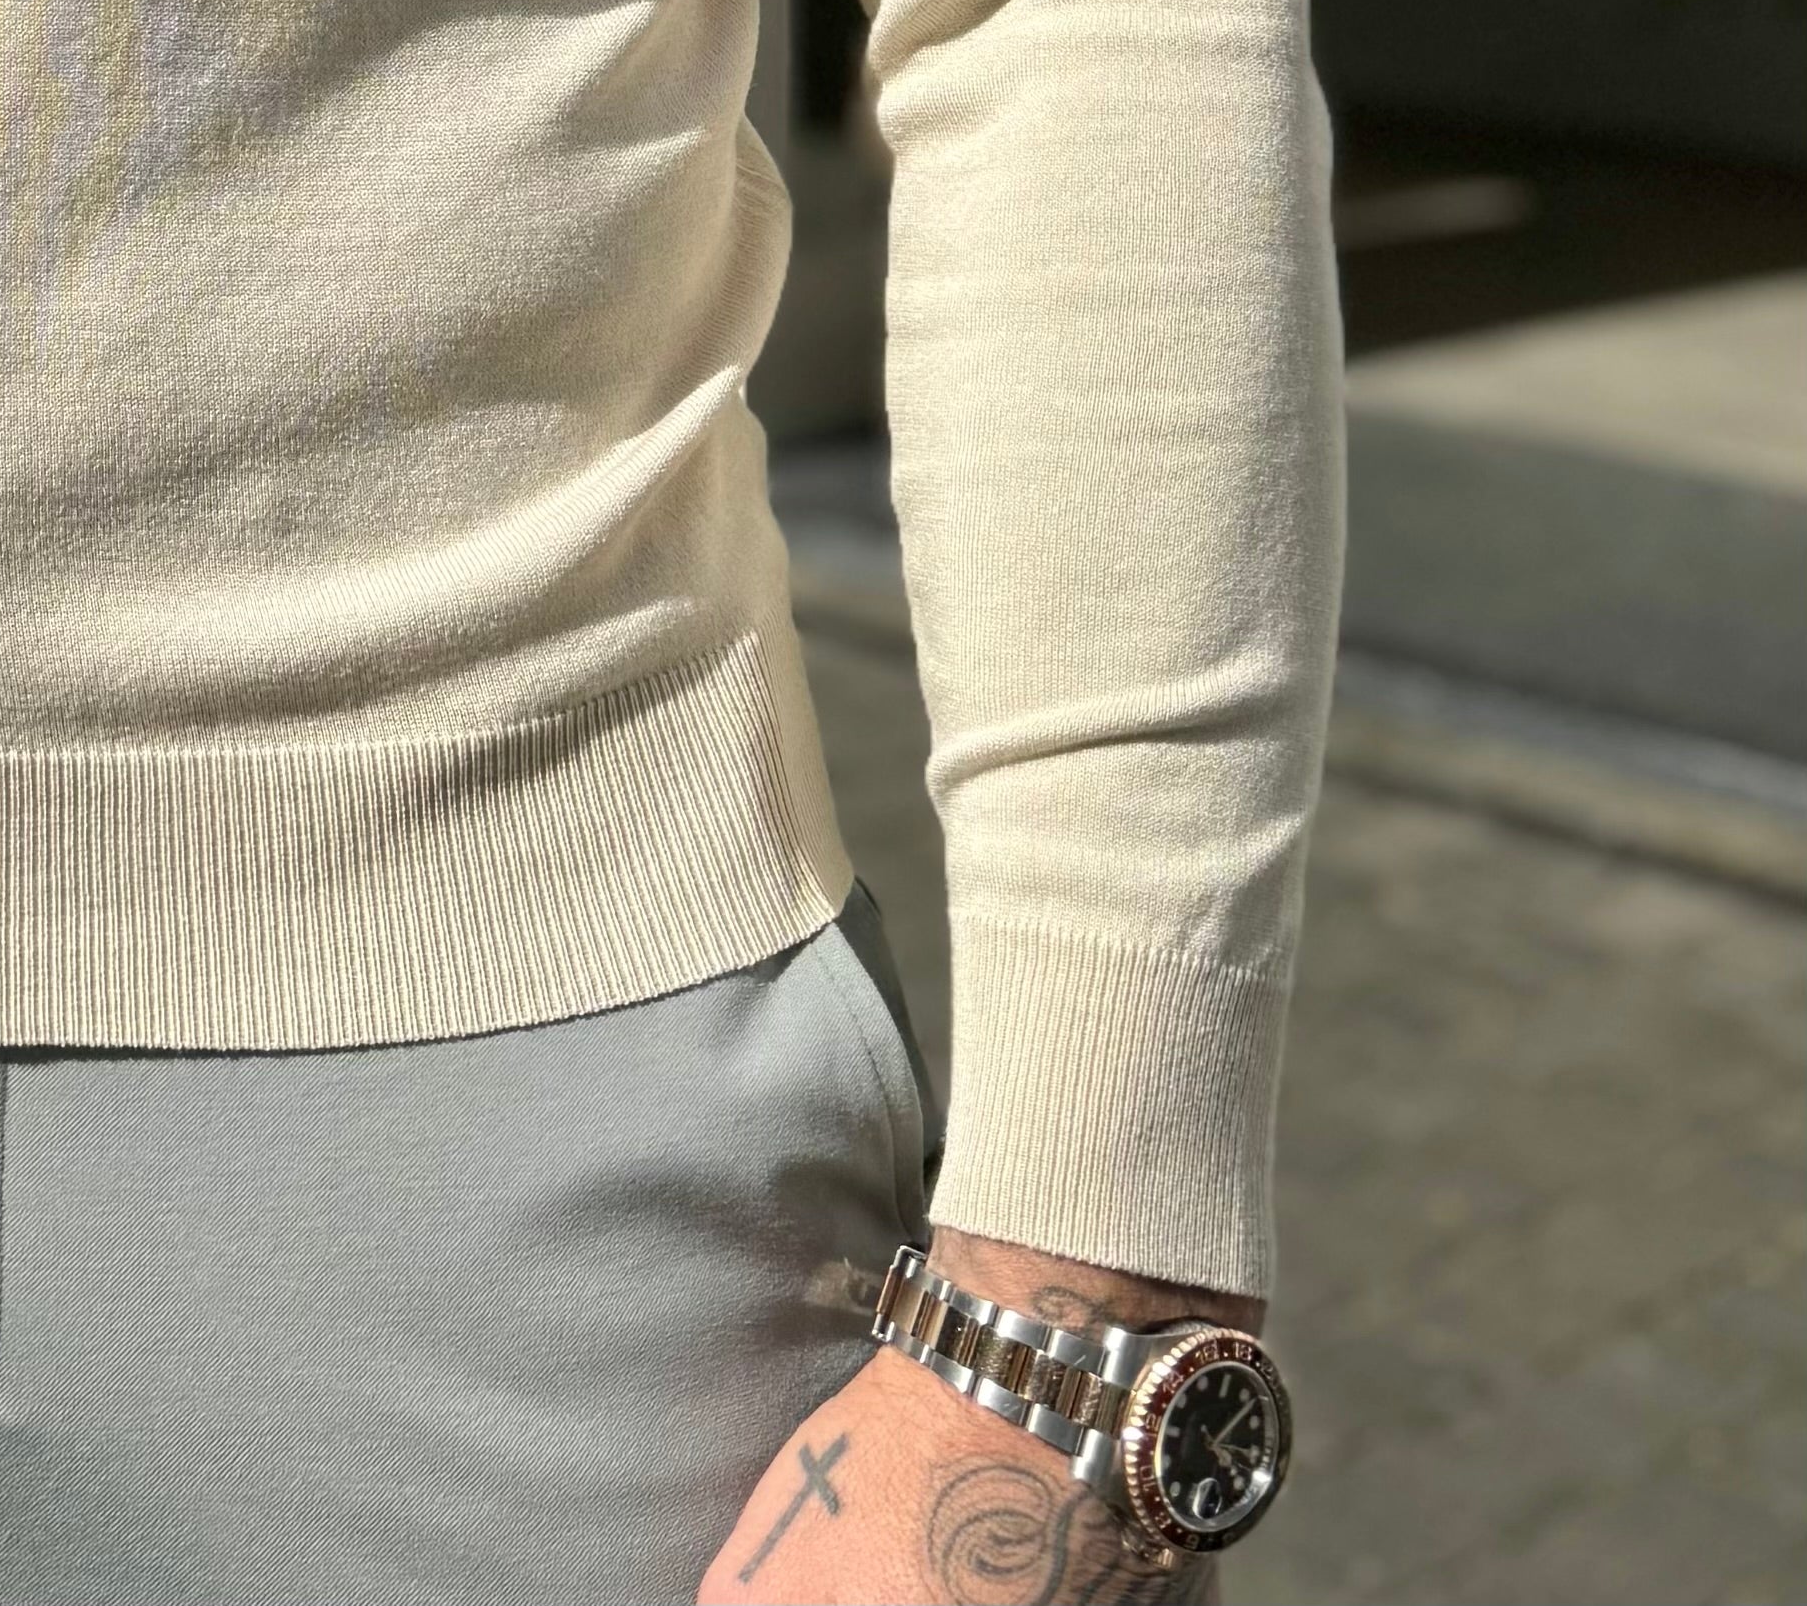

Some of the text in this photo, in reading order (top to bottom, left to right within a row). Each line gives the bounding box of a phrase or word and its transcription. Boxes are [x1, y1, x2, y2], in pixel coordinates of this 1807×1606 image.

[1232, 1341, 1253, 1362] 18
[1144, 1413, 1162, 1438] 12
[1139, 1465, 1156, 1492] 10
